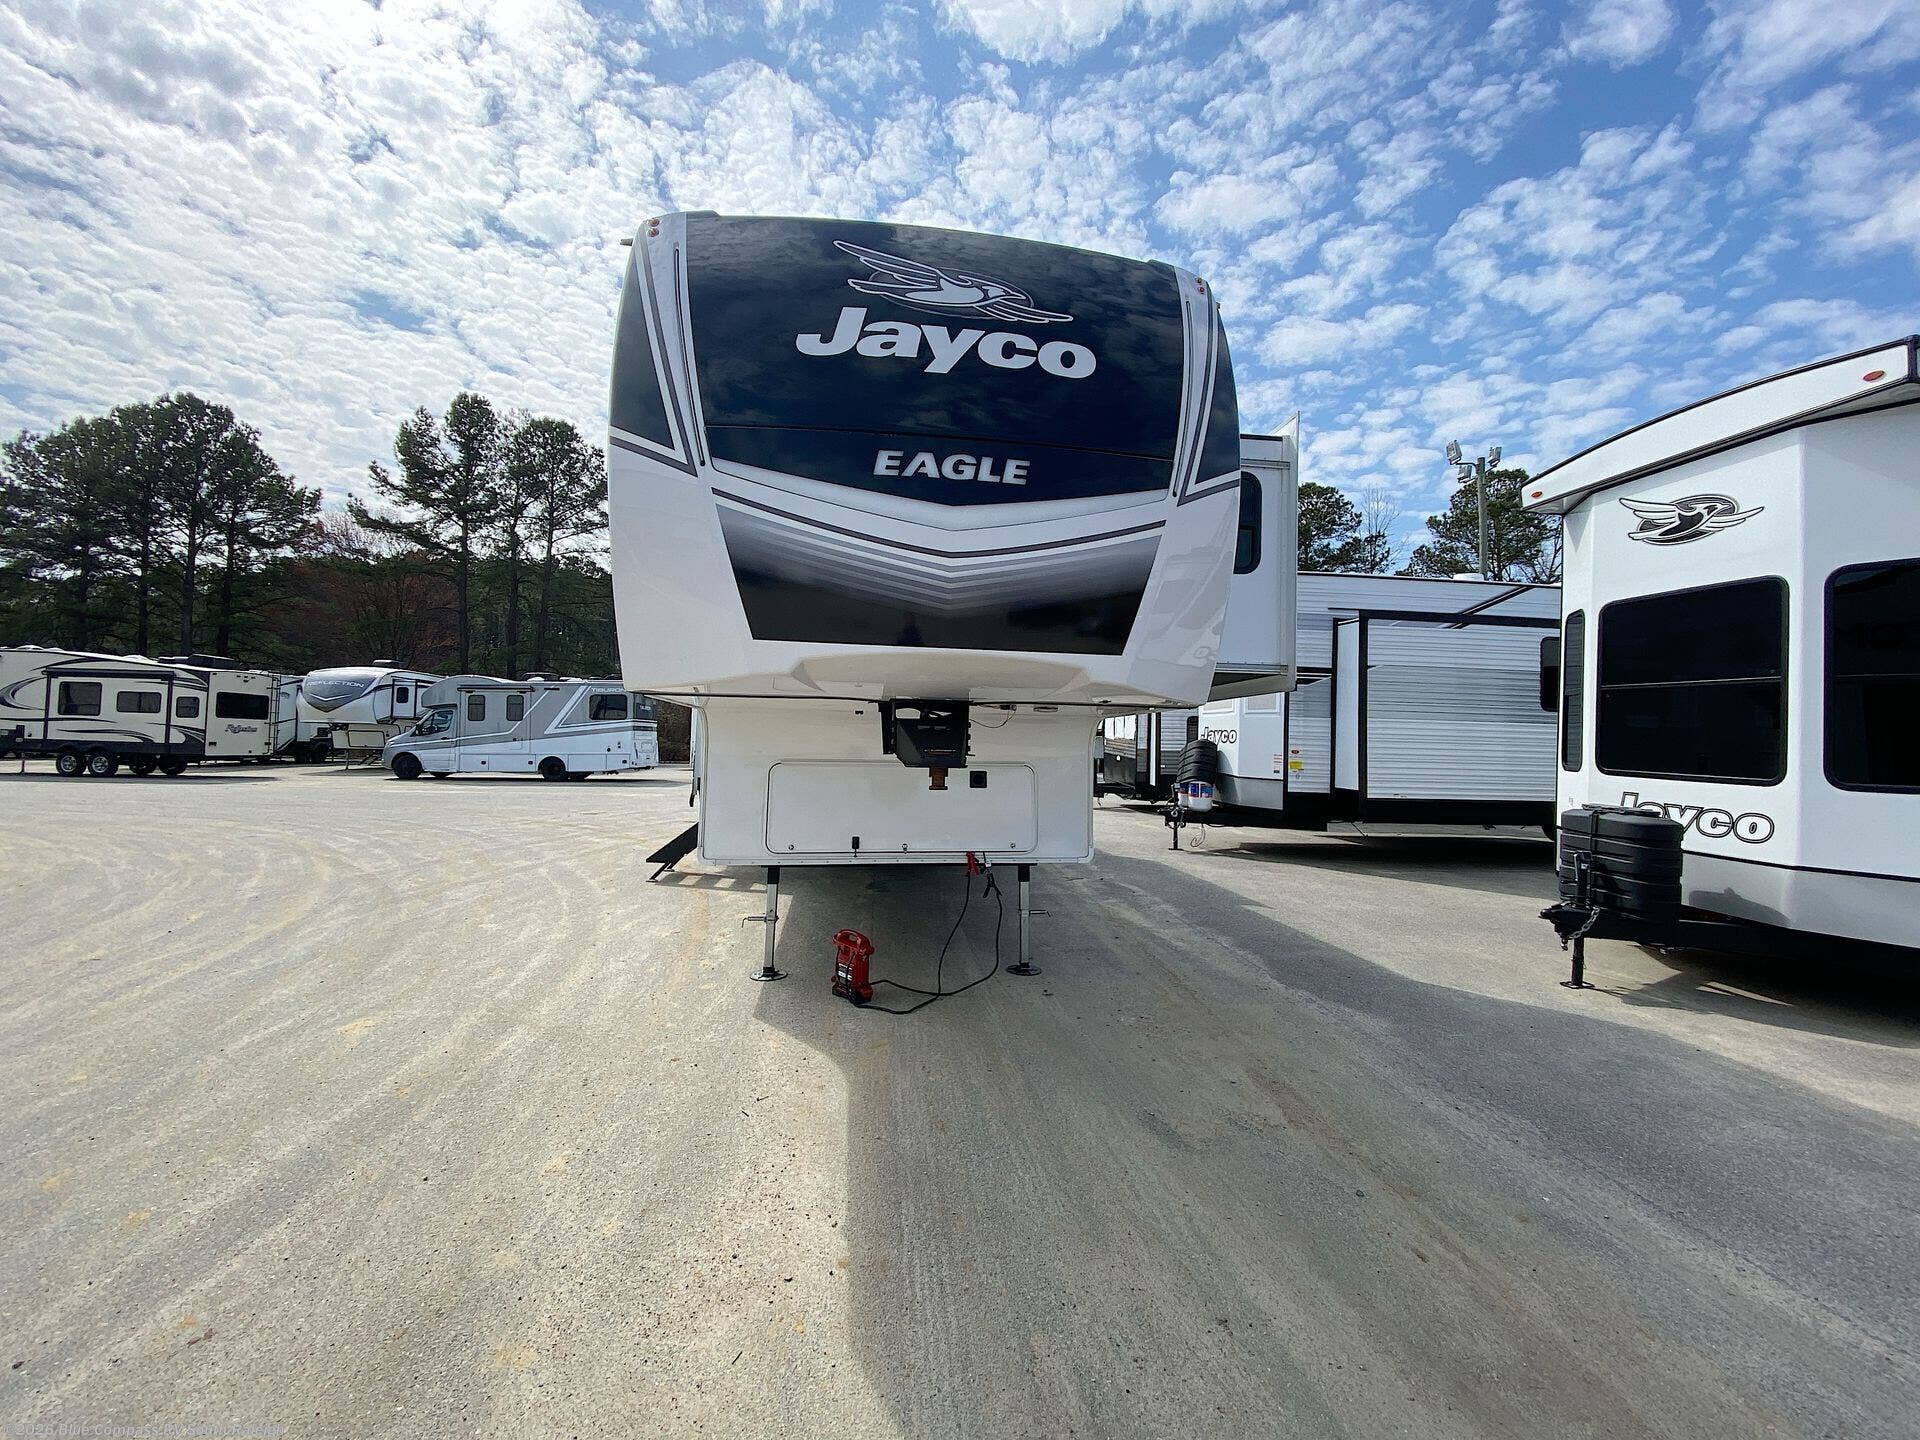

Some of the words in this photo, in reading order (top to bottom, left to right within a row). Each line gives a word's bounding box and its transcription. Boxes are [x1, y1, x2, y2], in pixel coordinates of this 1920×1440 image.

[795, 307, 1097, 379] Jayco
[873, 449, 1031, 485] EAGLE
[306, 680, 365, 688] REFLECTION
[1200, 726, 1238, 745] Jayco
